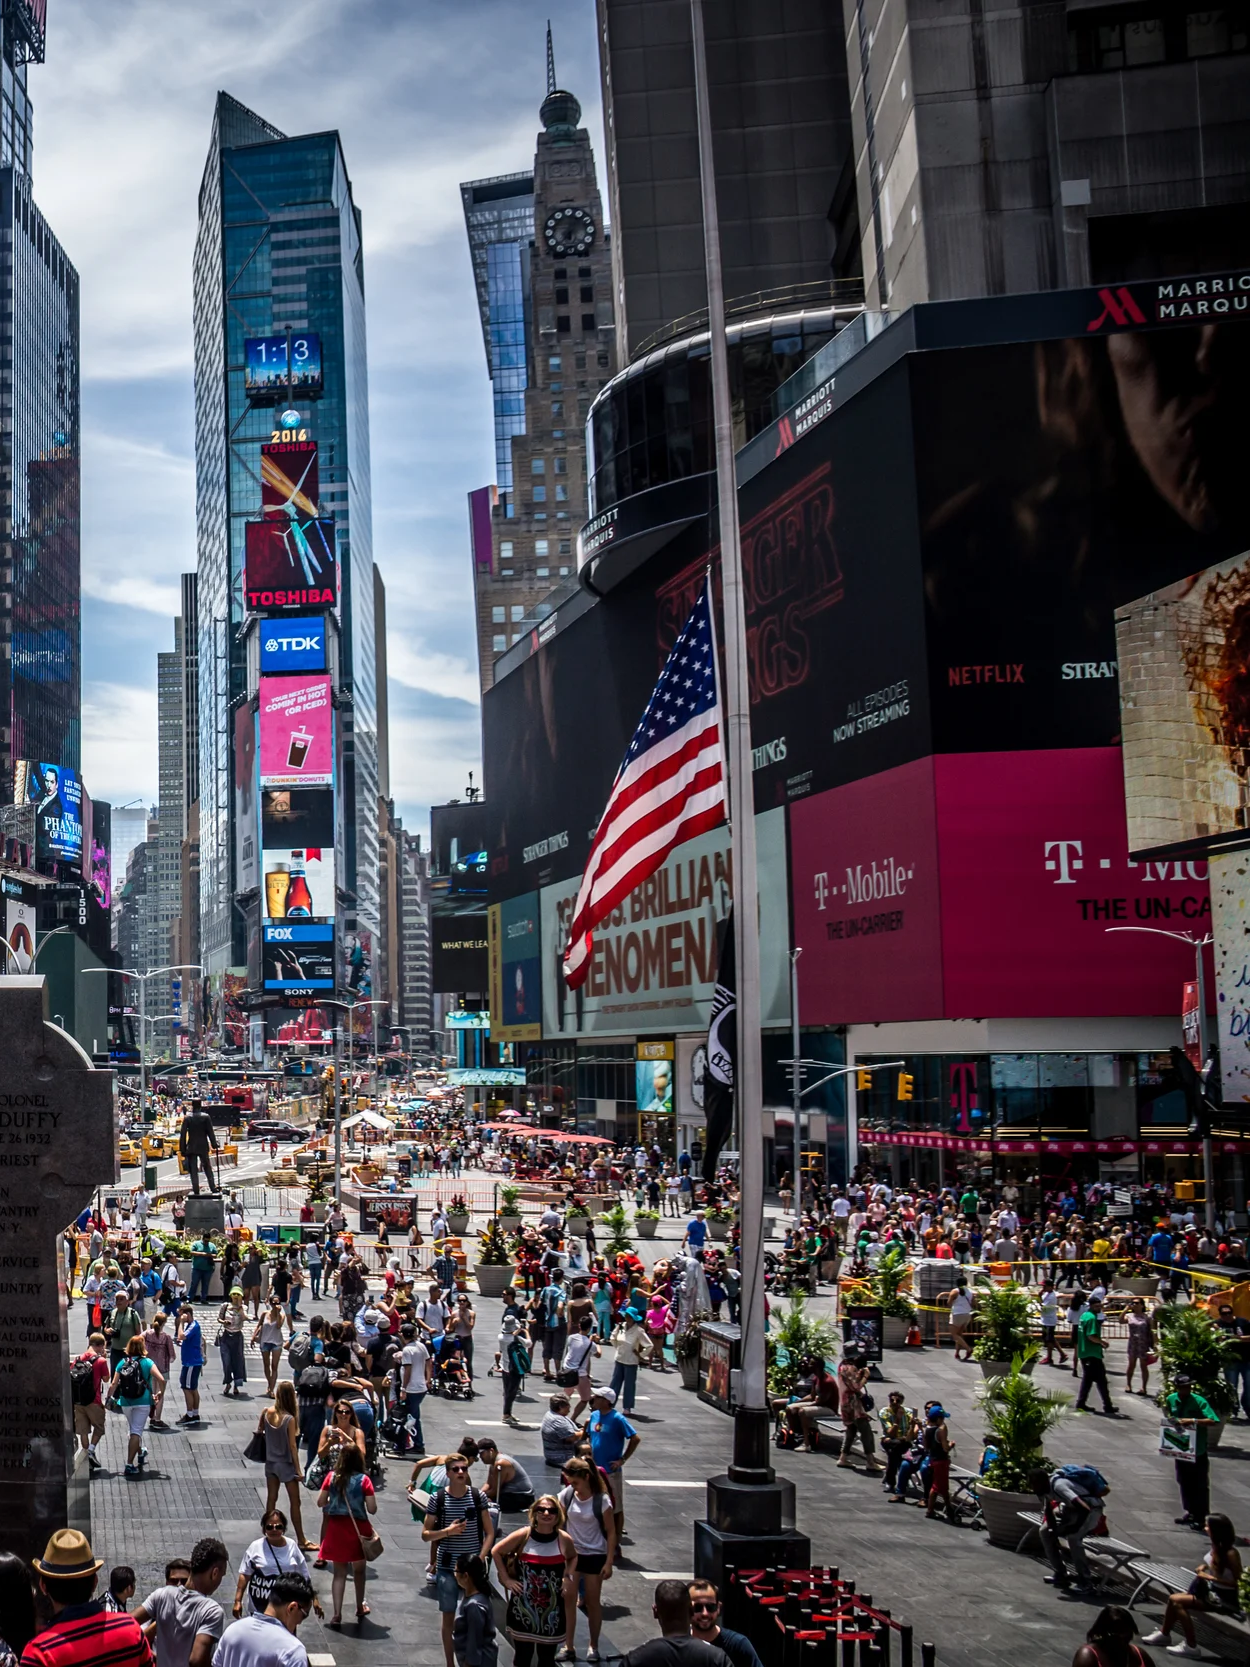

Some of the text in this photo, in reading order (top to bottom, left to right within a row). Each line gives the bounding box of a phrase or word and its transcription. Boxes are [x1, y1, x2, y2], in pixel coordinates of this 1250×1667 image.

[257, 340, 309, 363] 1:13
[795, 377, 836, 419] MARRIOTT
[796, 399, 832, 436] MARQUIS
[271, 429, 307, 443] 2016
[262, 442, 317, 453] TOSHIBA
[248, 589, 334, 606] TOSHIBA
[278, 637, 321, 651] TDK
[948, 663, 1025, 688] NETFLIX
[271, 683, 327, 703] YOUR NEXT ORDER
[297, 694, 307, 703] IN
[308, 689, 327, 700] HOT
[847, 680, 909, 719] ALL EPISODES
[285, 698, 327, 716] (OR ICED)
[833, 699, 910, 743] NOW STREAMING
[751, 736, 787, 771] THINGS
[786, 769, 814, 785] MARRIOTT
[787, 783, 811, 797] MARQUIS
[78, 889, 87, 925] 1500
[1077, 899, 1128, 920] THE
[826, 910, 904, 940] THE UN-CARRIER
[267, 928, 293, 940] FOX
[442, 941, 462, 950] WHAT
[463, 940, 474, 949] WE
[367, 1202, 391, 1213] JERSEY
[20, 1316, 45, 1328] WAR
[19, 1332, 59, 1343] GUARD
[26, 1397, 61, 1407] CROSS
[26, 1412, 63, 1423] MEDAL
[26, 1427, 61, 1438] CROSS
